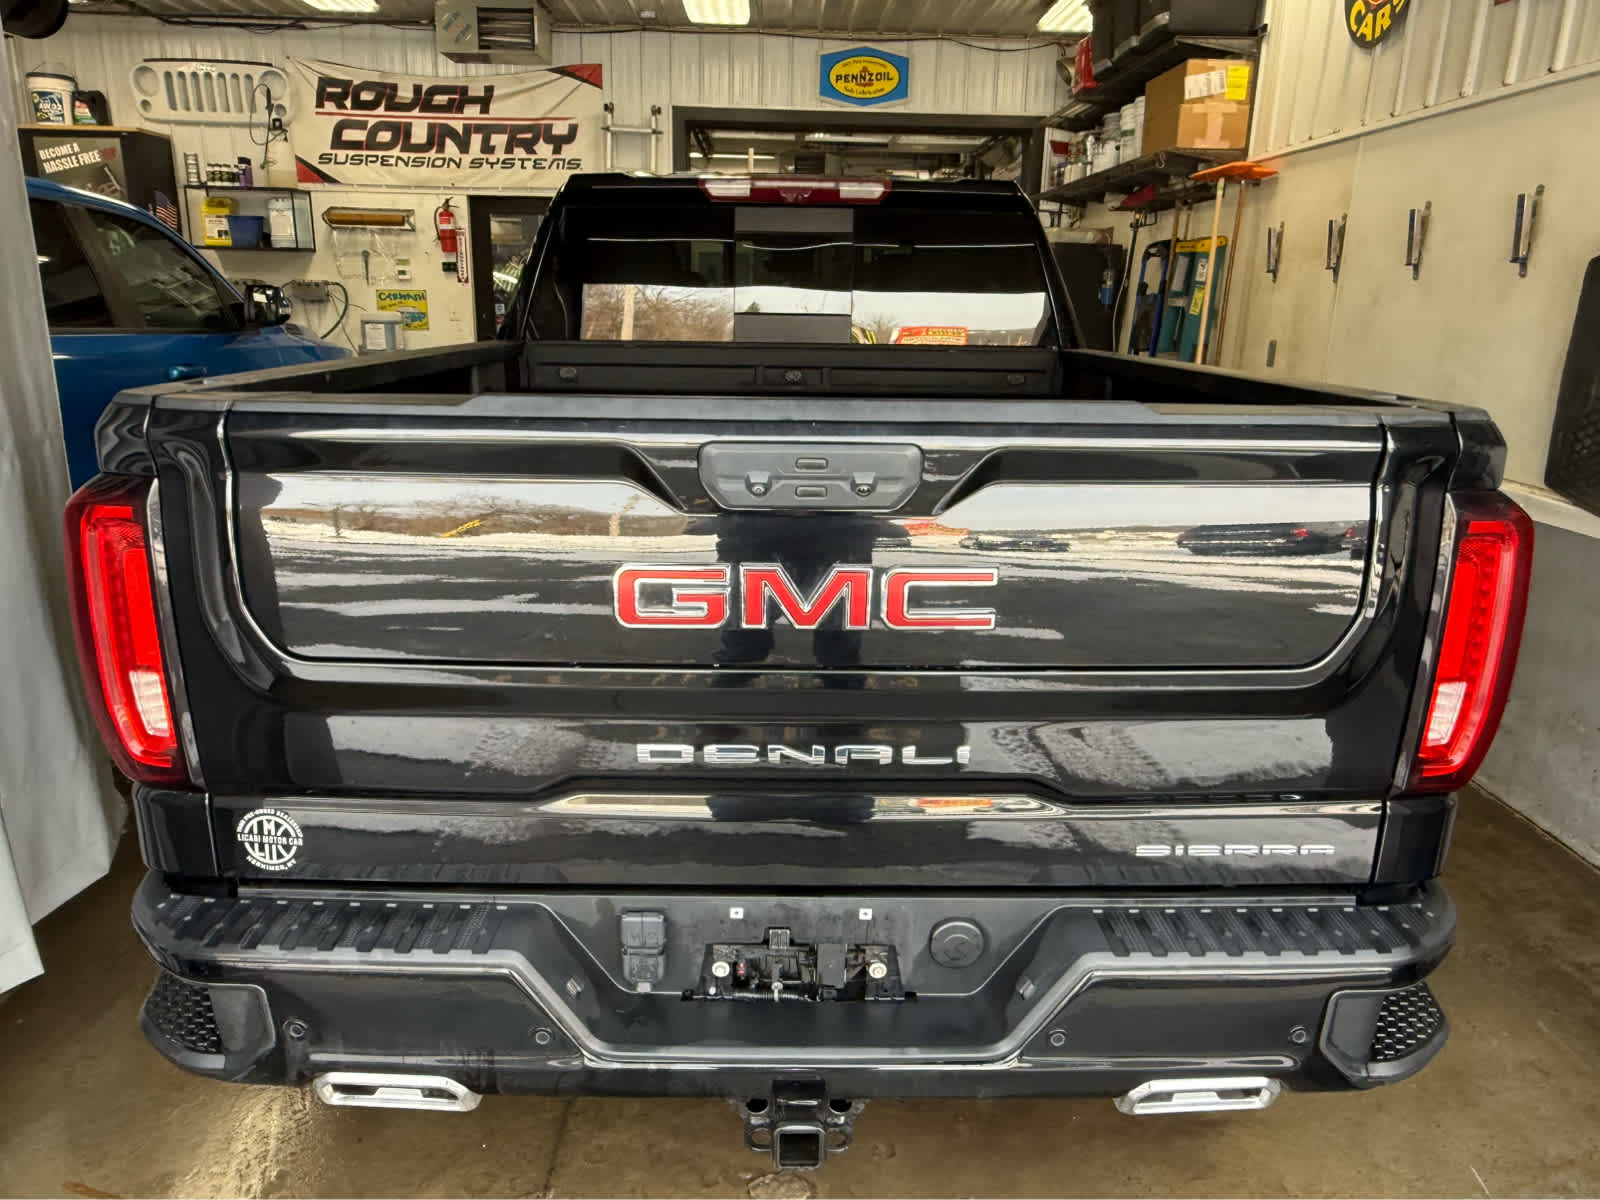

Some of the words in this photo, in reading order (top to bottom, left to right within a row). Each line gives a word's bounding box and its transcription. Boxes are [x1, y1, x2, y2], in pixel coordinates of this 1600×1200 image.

[835, 71, 894, 84] PENNZOIL
[315, 76, 495, 115] ROUGH
[330, 118, 579, 155] COUNTRY
[39, 146, 72, 160] BECOME
[72, 142, 80, 153] A
[317, 152, 462, 169] SUSPENSION
[43, 157, 80, 174] HASSLE
[79, 149, 101, 166] FREE
[613, 563, 999, 631] GMC
[636, 743, 971, 765] DENALI
[262, 835, 288, 846] MOTOR
[288, 837, 304, 847] CAR
[1135, 844, 1335, 857] SIERRA
